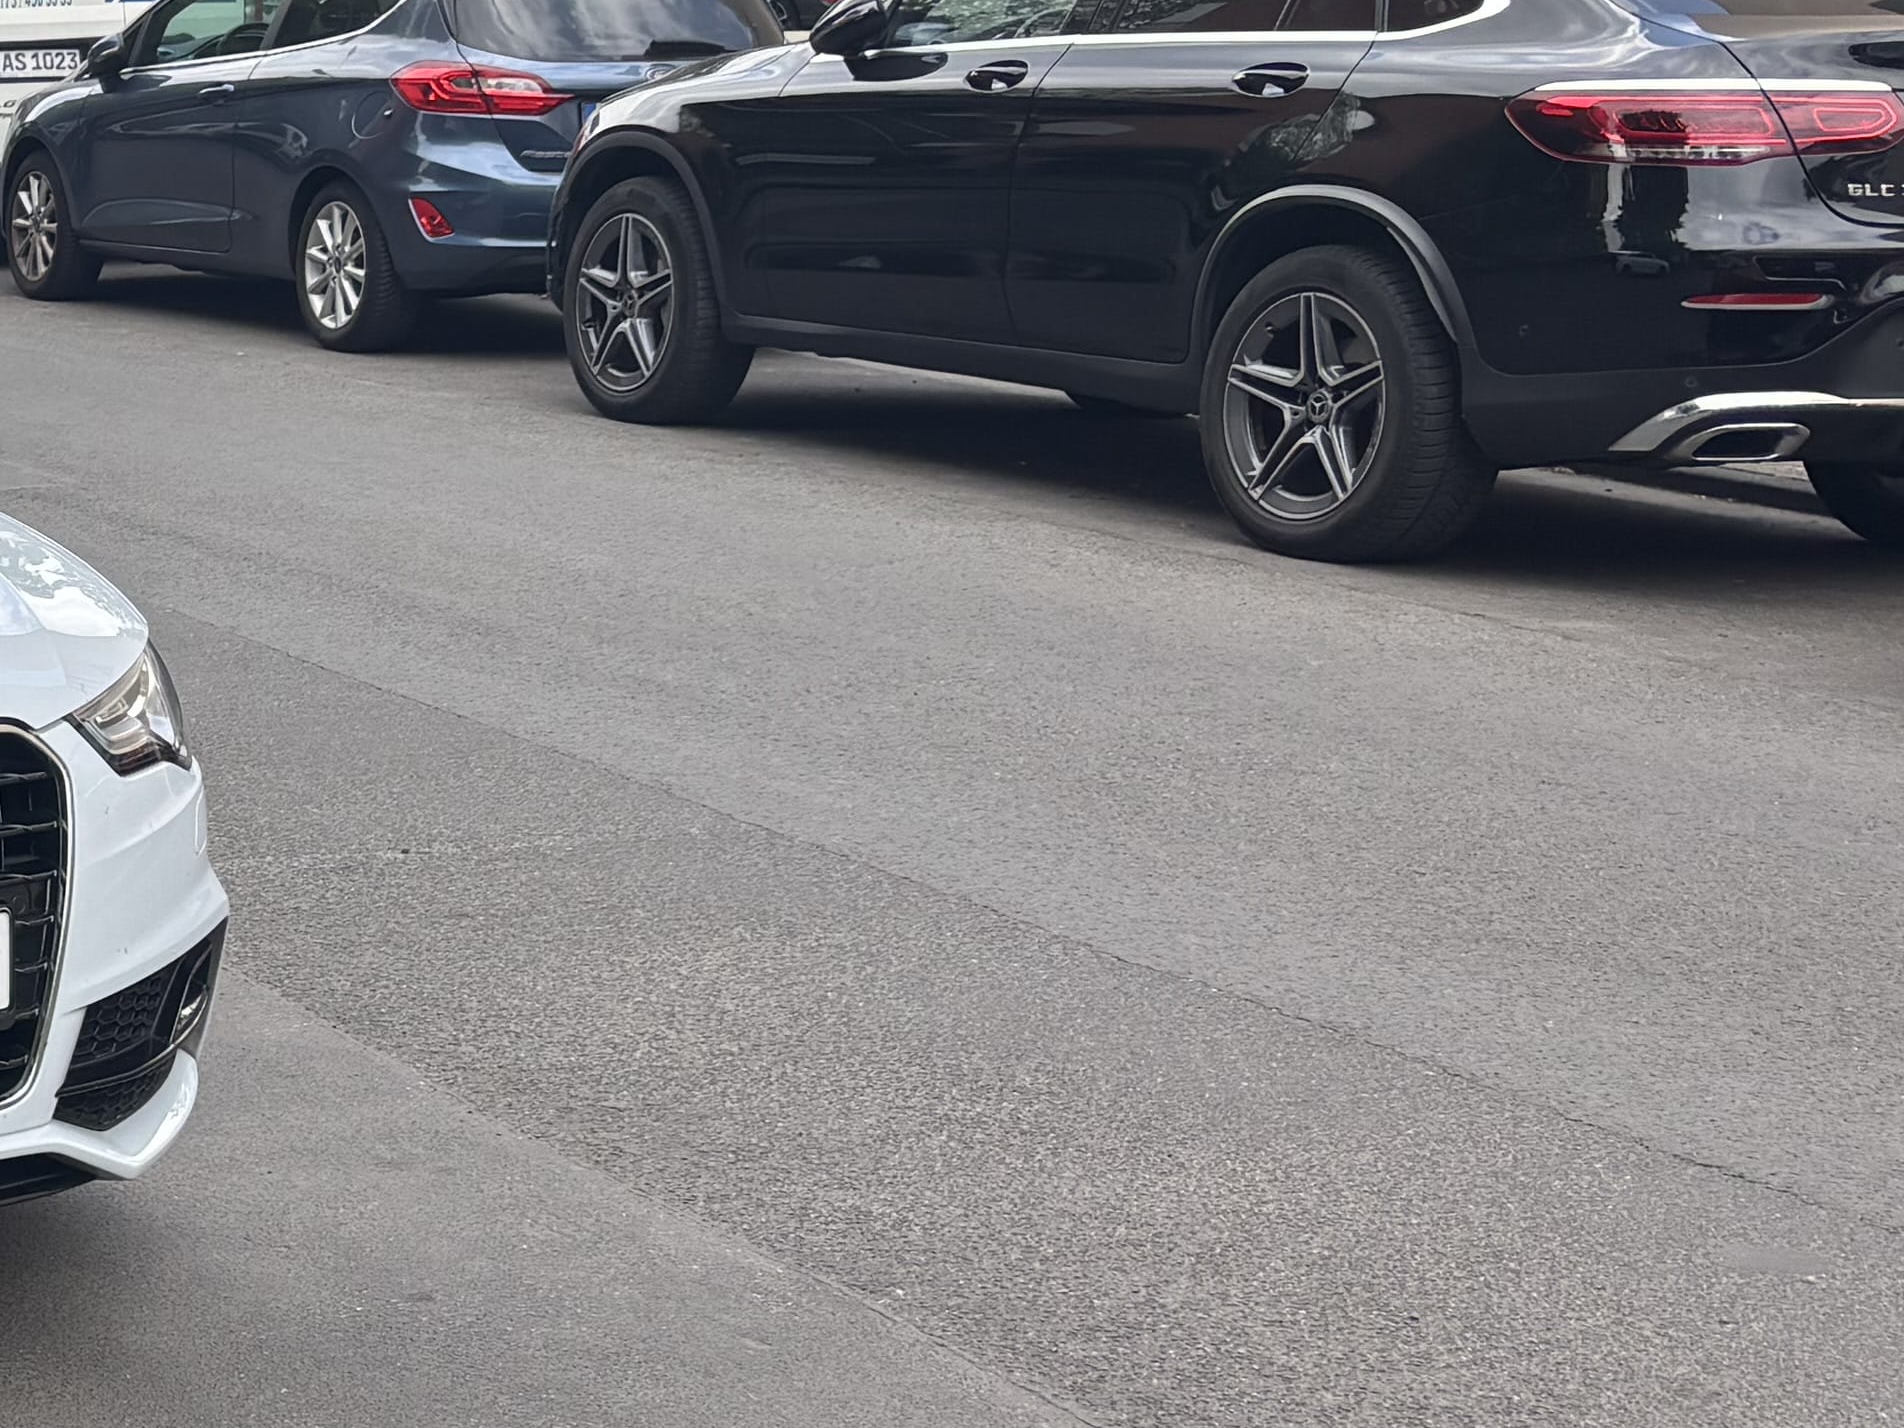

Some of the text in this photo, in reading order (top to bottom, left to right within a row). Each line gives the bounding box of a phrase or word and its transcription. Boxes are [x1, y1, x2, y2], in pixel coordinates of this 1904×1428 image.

[3, 53, 27, 72] AS
[31, 51, 78, 70] 1023
[1848, 184, 1896, 196] GLC
